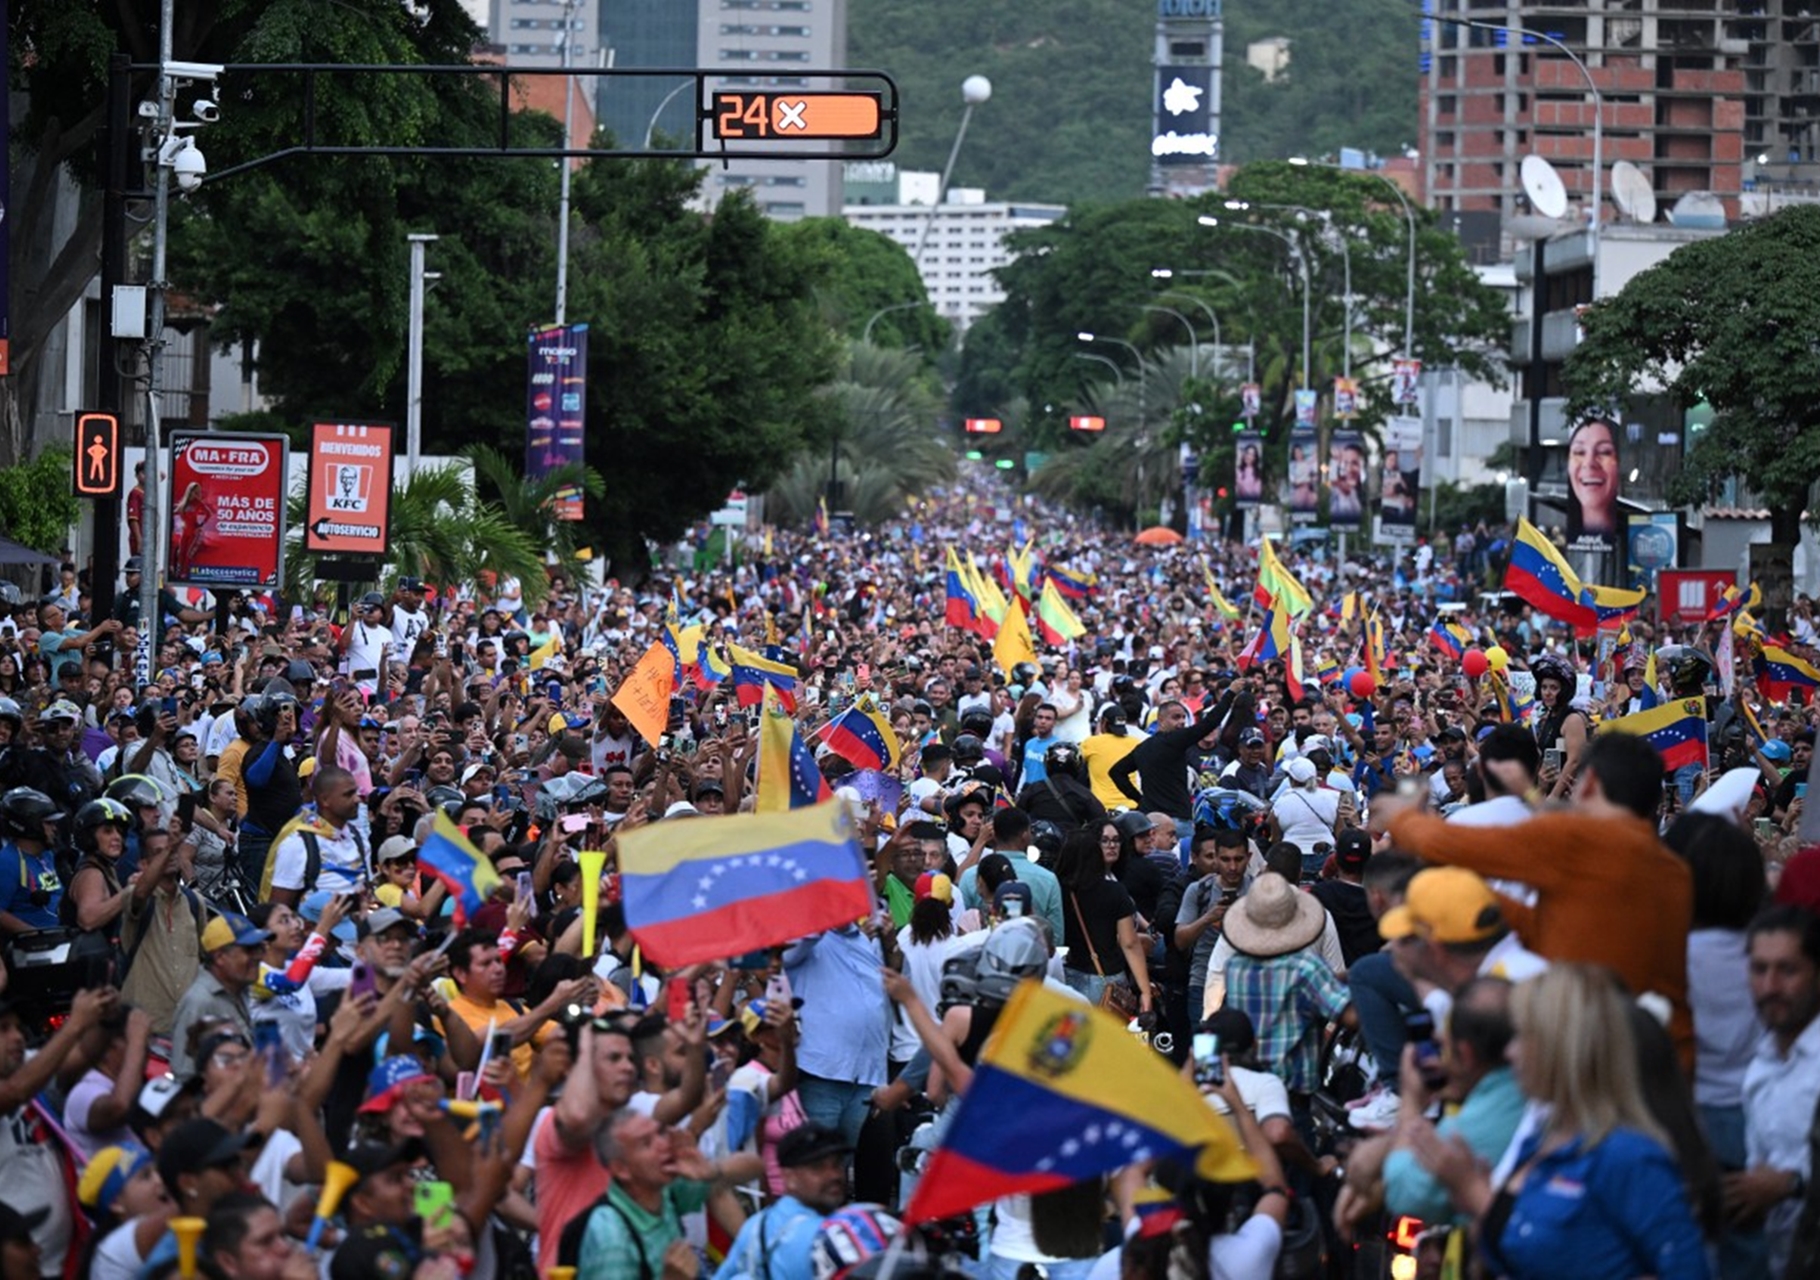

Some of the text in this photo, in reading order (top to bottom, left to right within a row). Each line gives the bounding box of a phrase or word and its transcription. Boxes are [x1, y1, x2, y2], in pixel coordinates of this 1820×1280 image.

[719, 95, 769, 136] 24
[319, 442, 382, 457] BIENVENIDOS
[217, 494, 274, 509] MÁS DE
[332, 498, 361, 510] KFC
[217, 508, 275, 522] 50 AÑOS
[317, 522, 379, 538] AUTOSERVICIO
